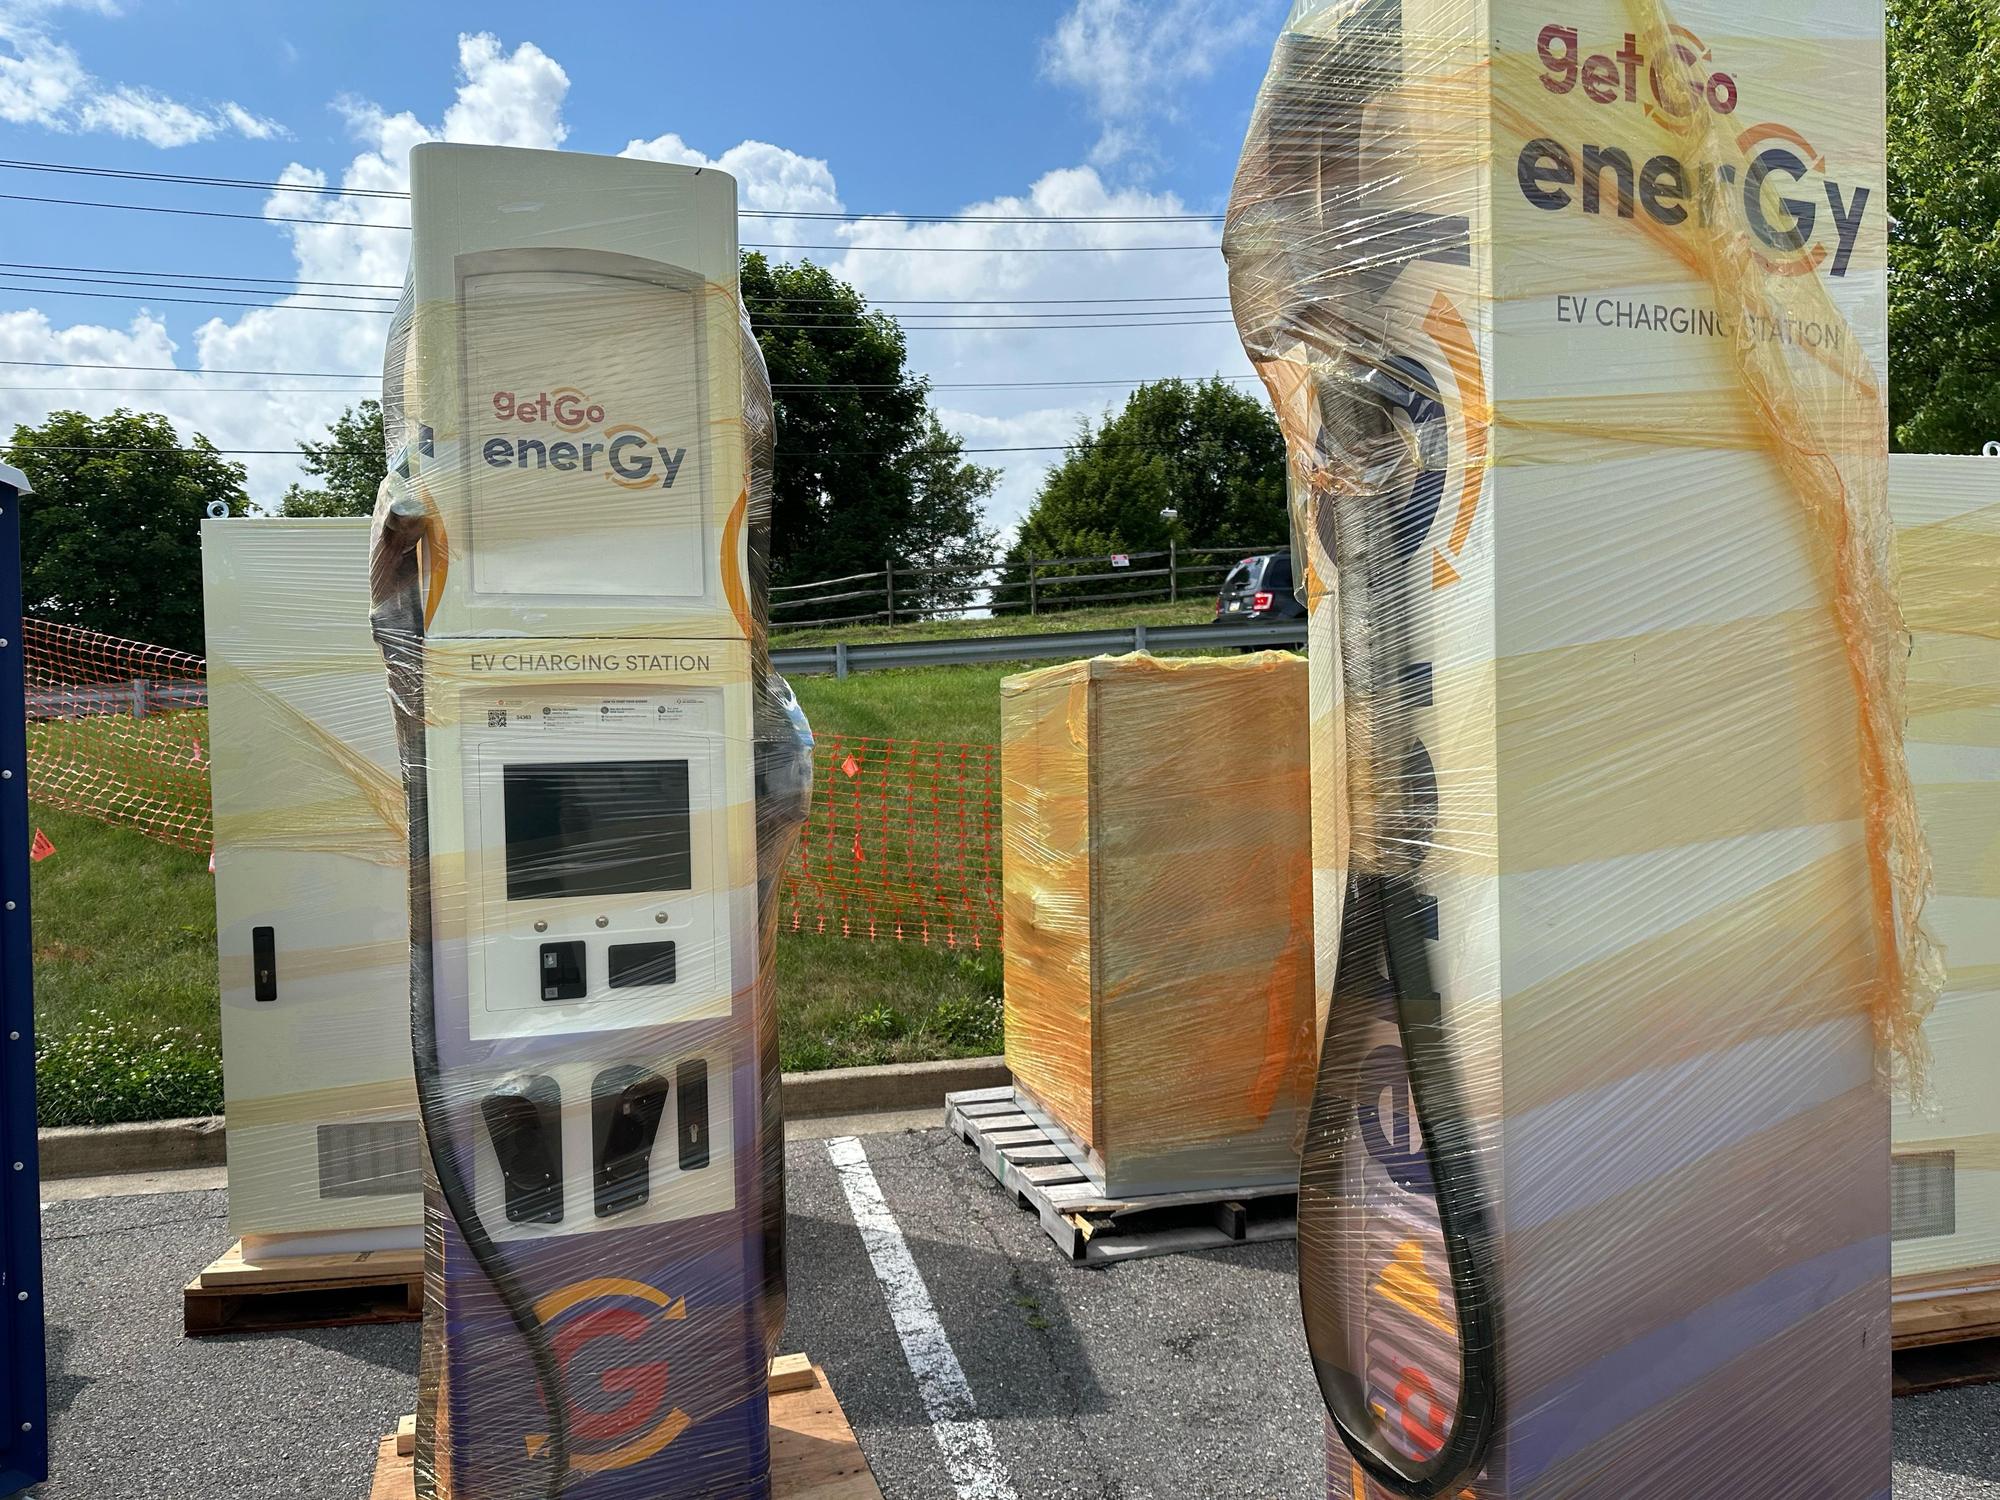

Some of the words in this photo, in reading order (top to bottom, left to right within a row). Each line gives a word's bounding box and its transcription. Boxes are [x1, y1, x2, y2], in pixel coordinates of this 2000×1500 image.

[1537, 23, 1738, 118] getGo
[1517, 137, 1871, 278] enerGy
[1557, 295, 1587, 323] EV
[1595, 298, 1736, 338] CHARGING
[492, 391, 605, 427] getGo
[482, 434, 687, 489] enerGy
[471, 654, 495, 671] EV
[502, 654, 620, 671] CHARGING
[626, 655, 710, 671] STATION
